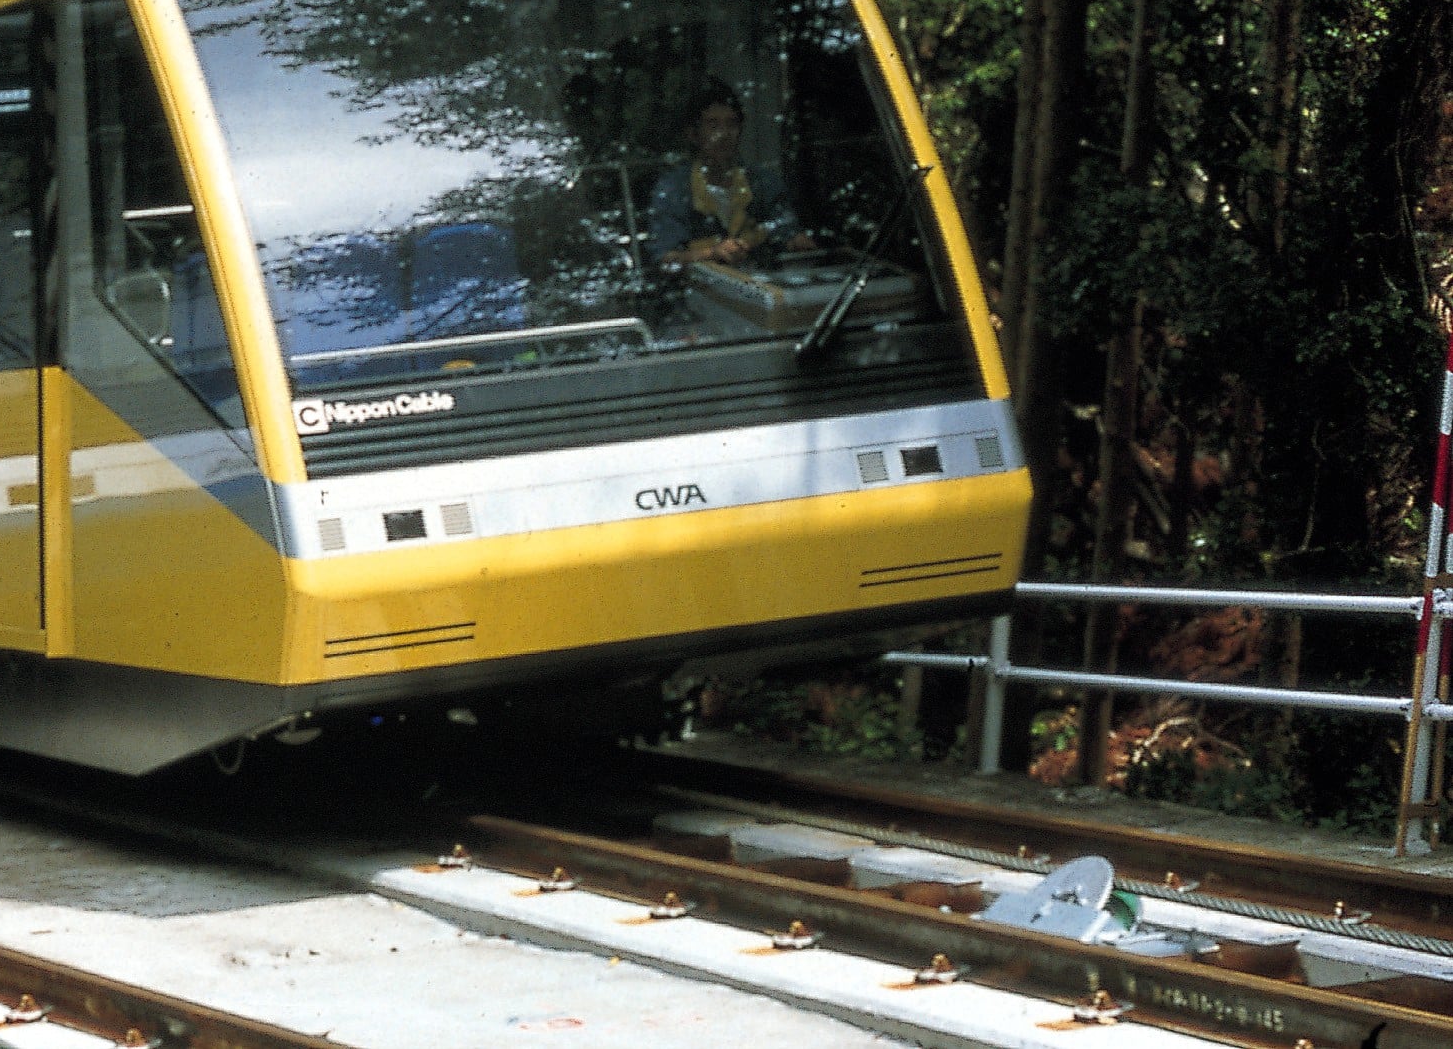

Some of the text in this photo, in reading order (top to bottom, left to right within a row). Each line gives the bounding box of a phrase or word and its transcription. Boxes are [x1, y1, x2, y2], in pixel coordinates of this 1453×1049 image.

[326, 401, 395, 423] Nippon
[395, 392, 455, 415] Cable
[636, 484, 707, 510] CWA
